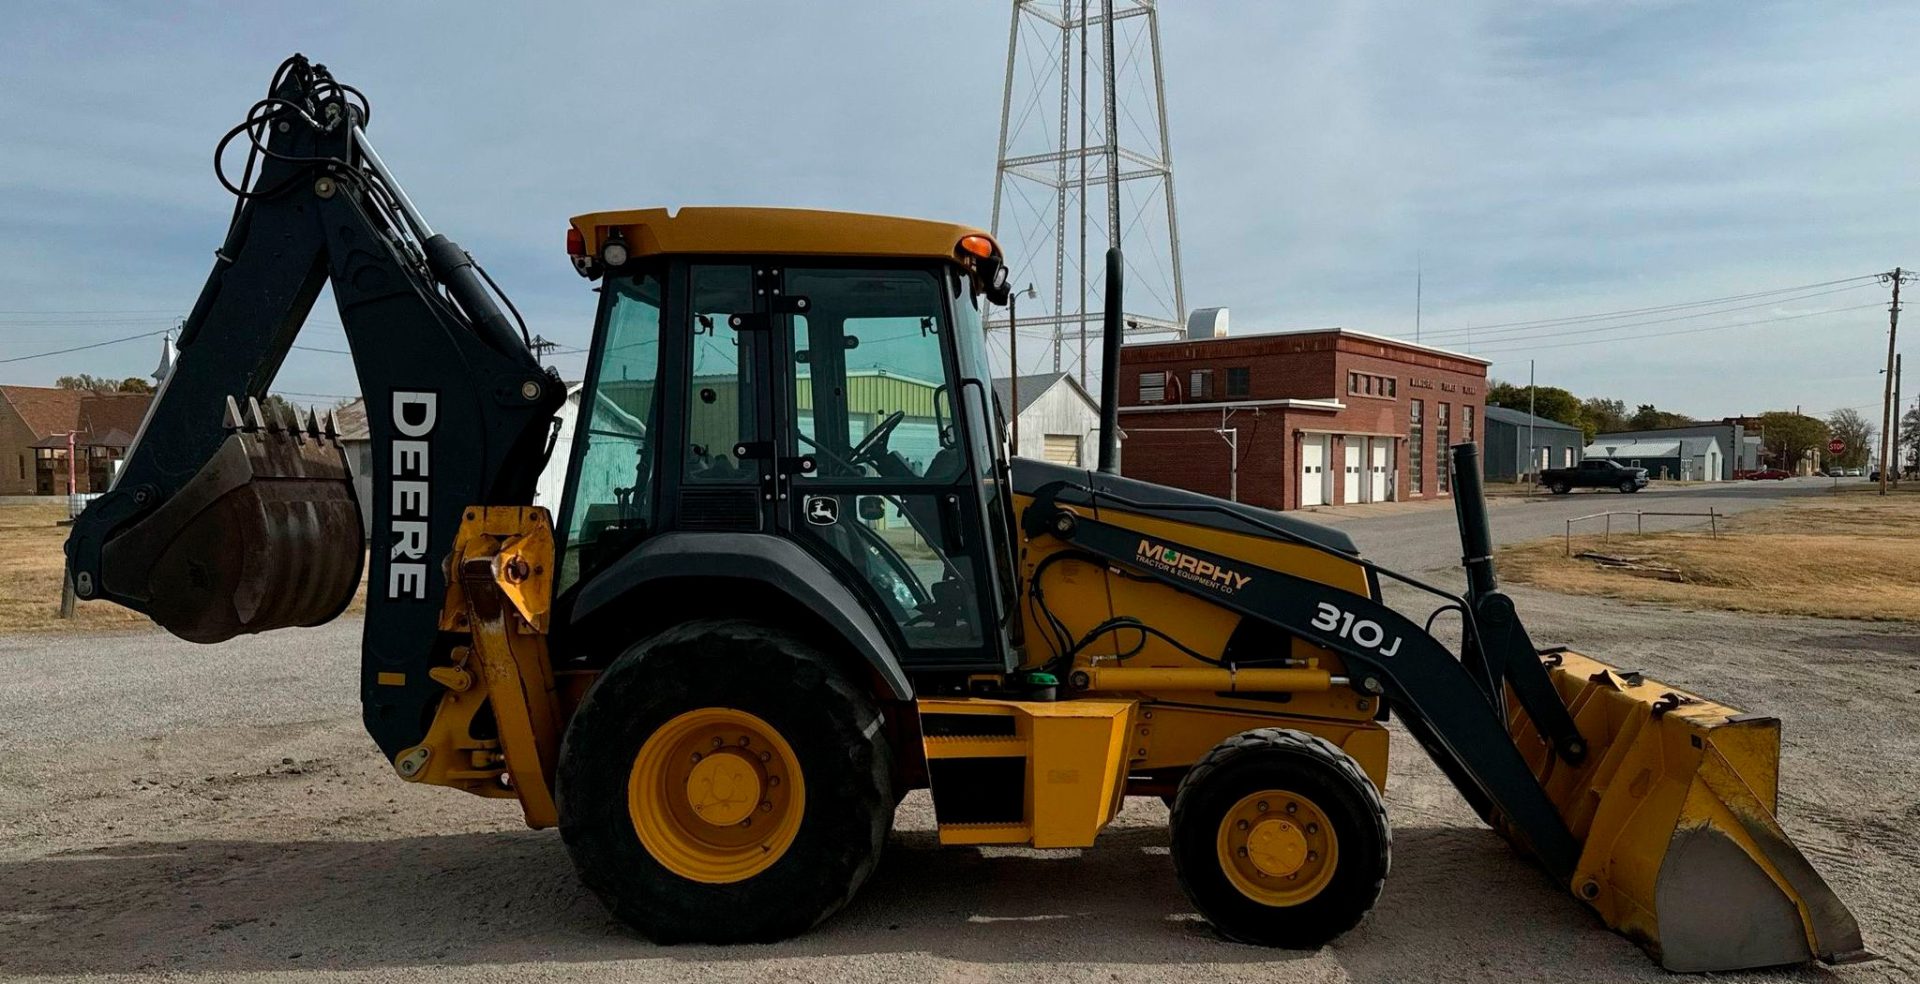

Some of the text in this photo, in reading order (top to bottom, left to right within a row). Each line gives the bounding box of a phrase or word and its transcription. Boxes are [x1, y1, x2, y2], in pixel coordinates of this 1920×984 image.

[389, 391, 437, 599] DEERE
[1136, 554, 1234, 595] TRACTOR & EQUIPMENT CO.
[1137, 539, 1252, 590] MURPHY
[1311, 601, 1402, 657] 310J
